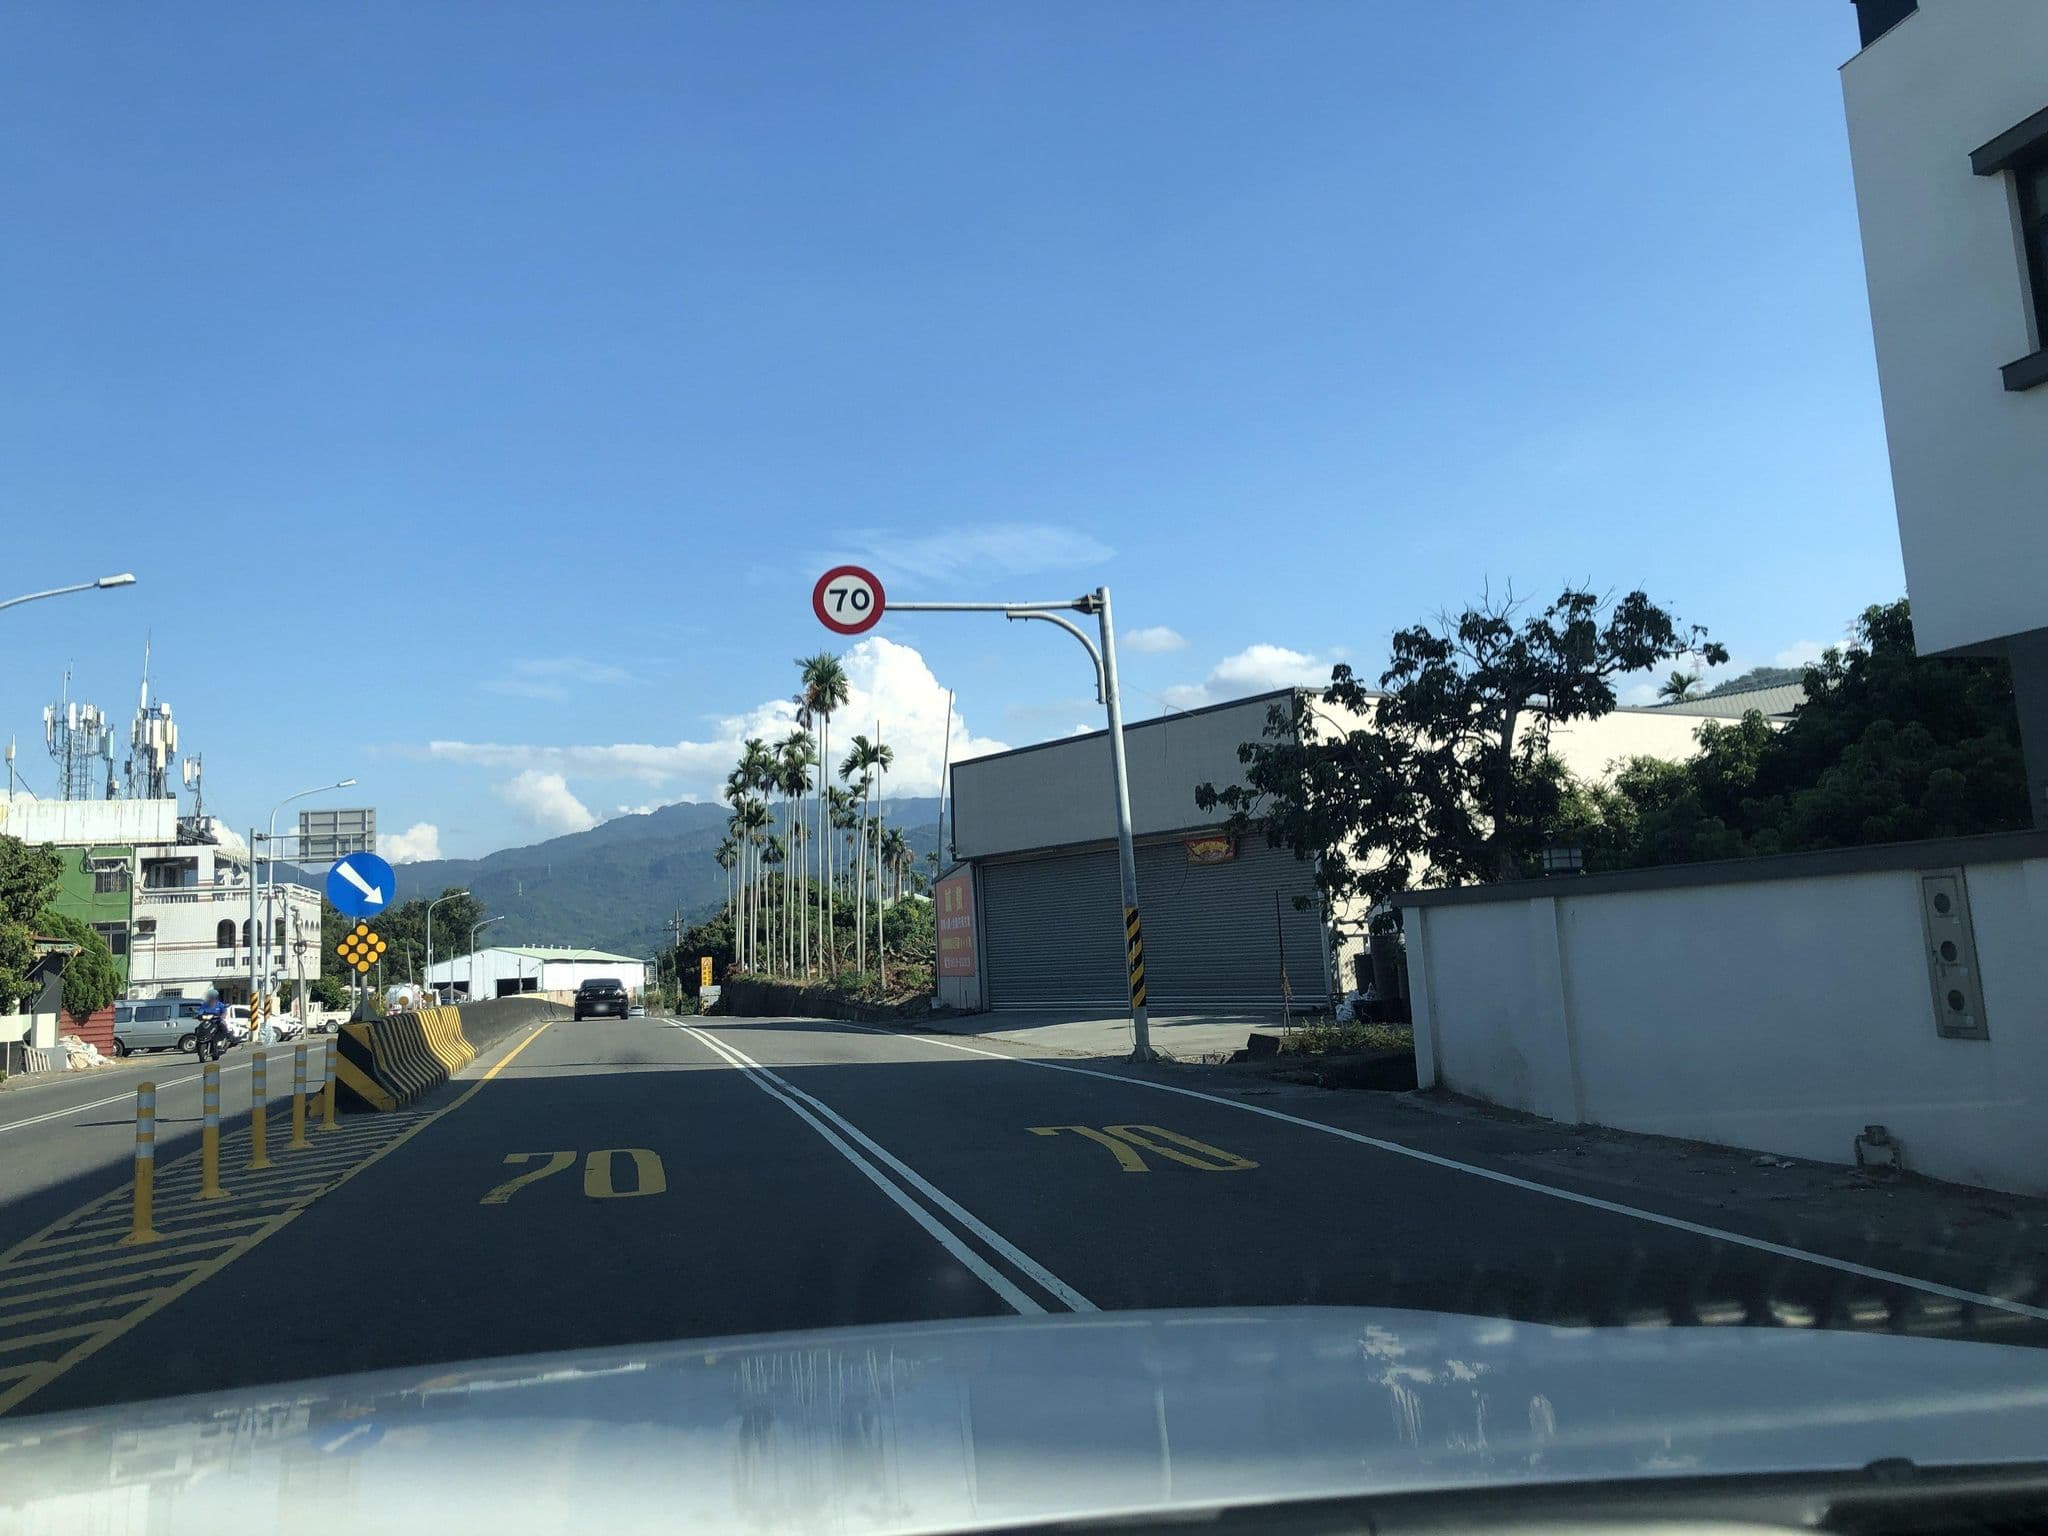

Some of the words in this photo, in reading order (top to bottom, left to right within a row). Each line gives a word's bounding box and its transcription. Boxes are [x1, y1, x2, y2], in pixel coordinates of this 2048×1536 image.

[829, 588, 870, 613] 70
[1024, 1125, 1261, 1172] 70
[480, 1148, 667, 1204] 70
